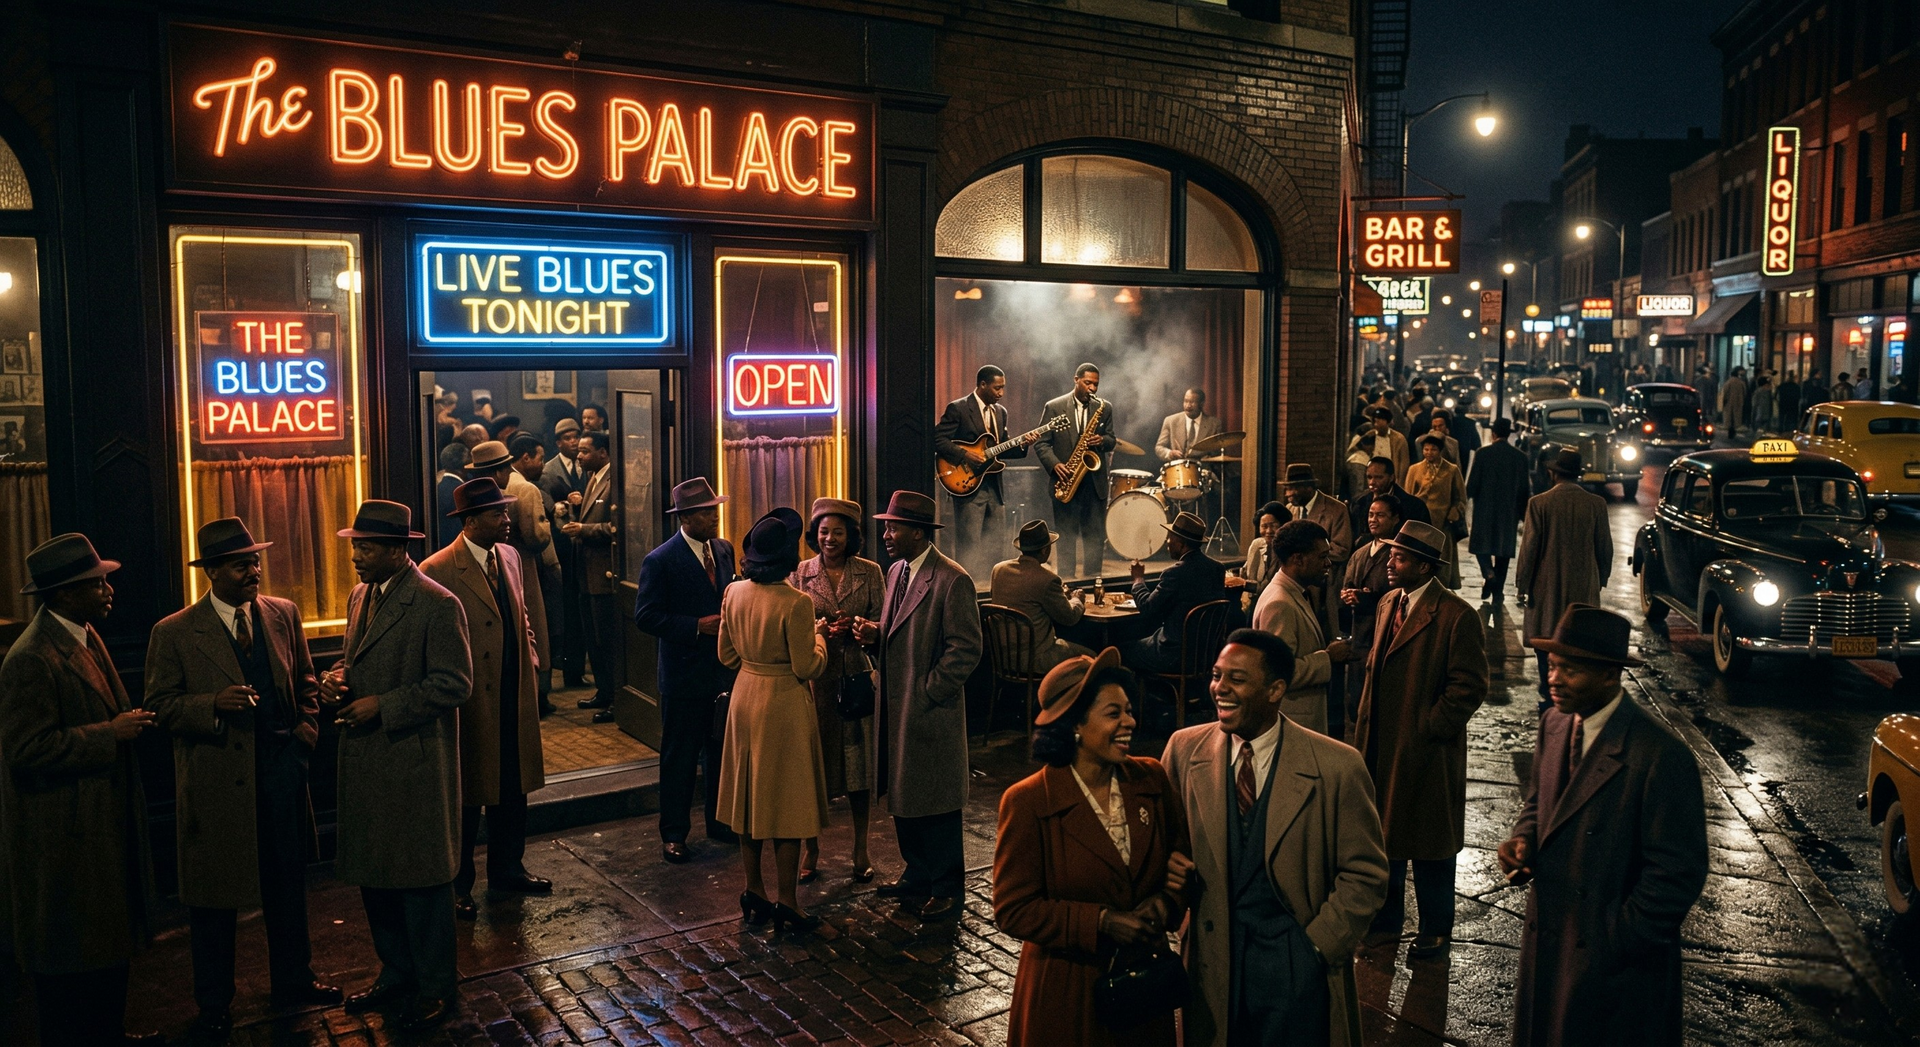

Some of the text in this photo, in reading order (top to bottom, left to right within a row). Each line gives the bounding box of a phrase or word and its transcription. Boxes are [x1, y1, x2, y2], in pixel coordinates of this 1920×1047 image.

[193, 57, 857, 199] The BLUES PALACE
[1768, 133, 1793, 269] LIQUOR
[1365, 217, 1453, 240] BAR &
[1365, 243, 1451, 267] GRILL
[435, 253, 656, 296] LIVE BLUES
[461, 298, 630, 335] TONIGHT
[235, 319, 305, 355] THE
[214, 360, 327, 395] BLUES
[735, 362, 832, 407] OPEN
[207, 400, 336, 435] PALACE
